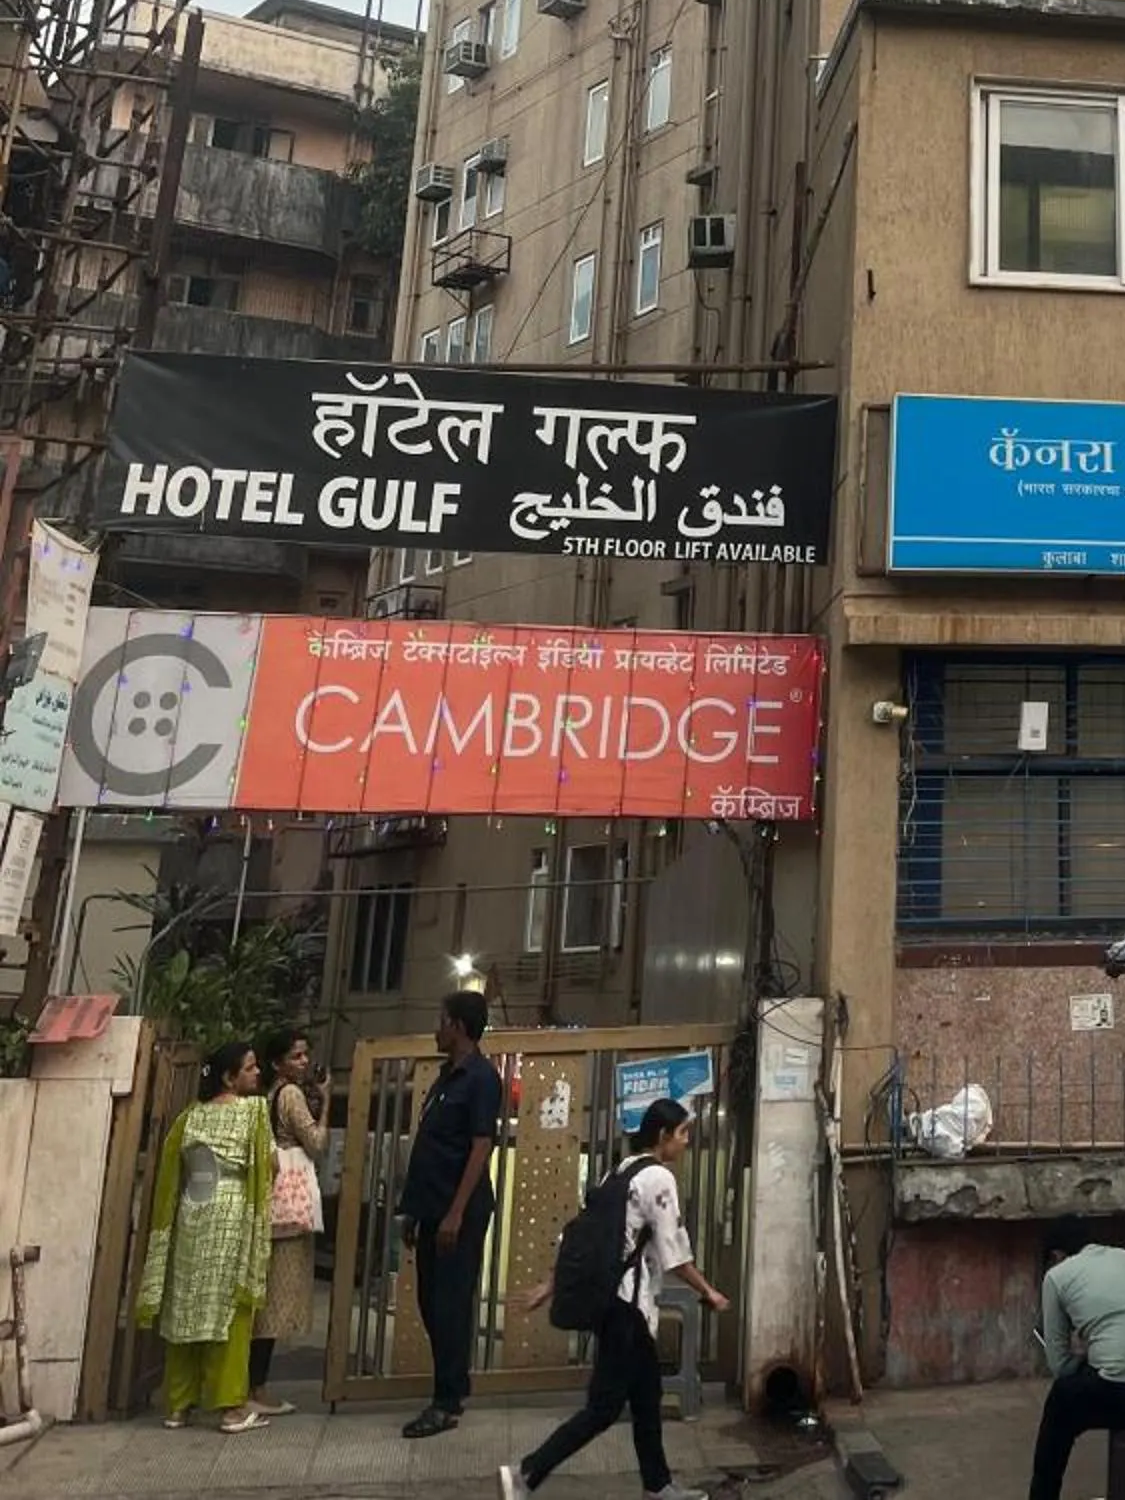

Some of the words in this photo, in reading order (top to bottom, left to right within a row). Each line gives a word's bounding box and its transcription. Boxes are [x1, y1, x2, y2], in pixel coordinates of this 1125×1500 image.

[311, 372, 504, 464] हॉटेल
[533, 406, 697, 473] गल्फ
[989, 427, 1116, 473] कॅनरा
[119, 462, 305, 526] HOTEL
[317, 476, 462, 533] GULF
[508, 472, 657, 541] الخليج
[676, 483, 786, 537] فندق
[561, 536, 598, 555] 5TH
[603, 538, 667, 558] FLOOR
[674, 541, 713, 560] LIFT
[715, 543, 817, 564] AVAILABLE
[1041, 550, 1088, 570] कुलाबा
[295, 685, 783, 764] CAMBRIDGE
